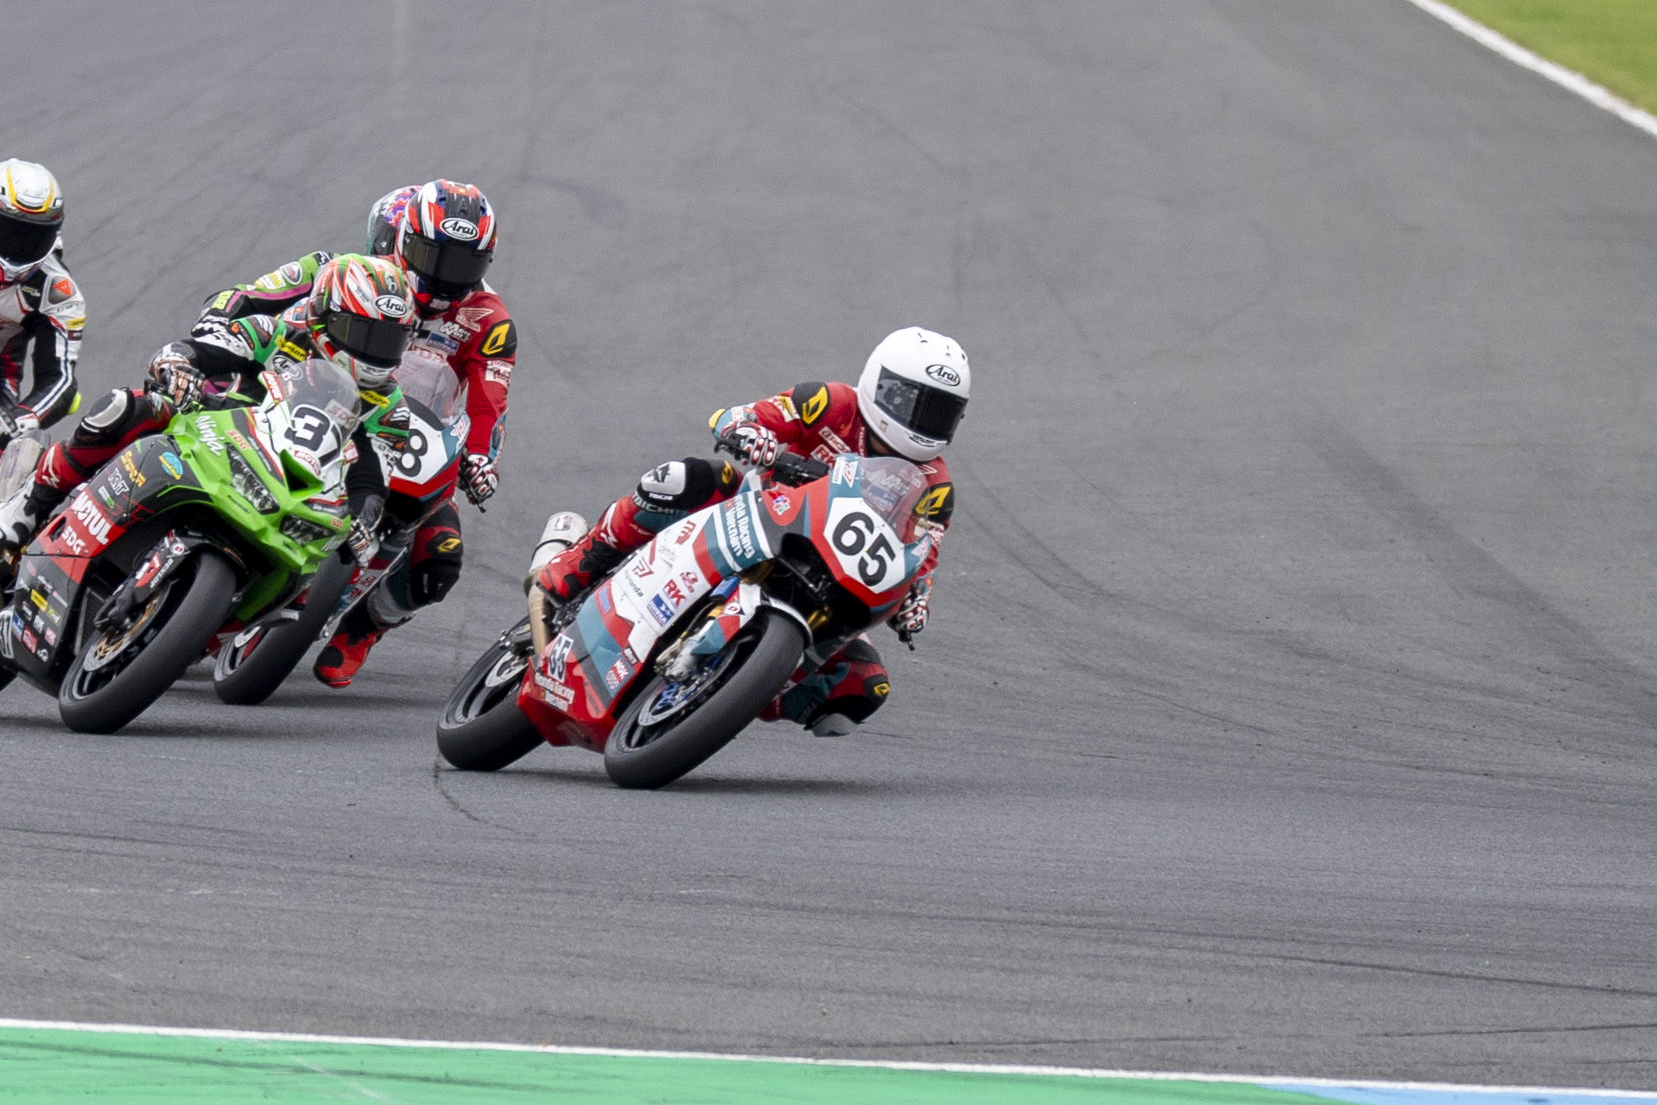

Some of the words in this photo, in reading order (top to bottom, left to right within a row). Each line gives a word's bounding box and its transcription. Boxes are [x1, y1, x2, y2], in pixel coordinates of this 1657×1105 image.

[442, 220, 477, 237] Arai
[377, 298, 405, 315] Arai
[929, 364, 960, 385] Arai
[71, 489, 117, 546] MOTUL
[725, 507, 744, 557] Vietnam
[60, 527, 86, 556] SDG
[737, 517, 755, 559] Racing
[832, 511, 896, 587] 65
